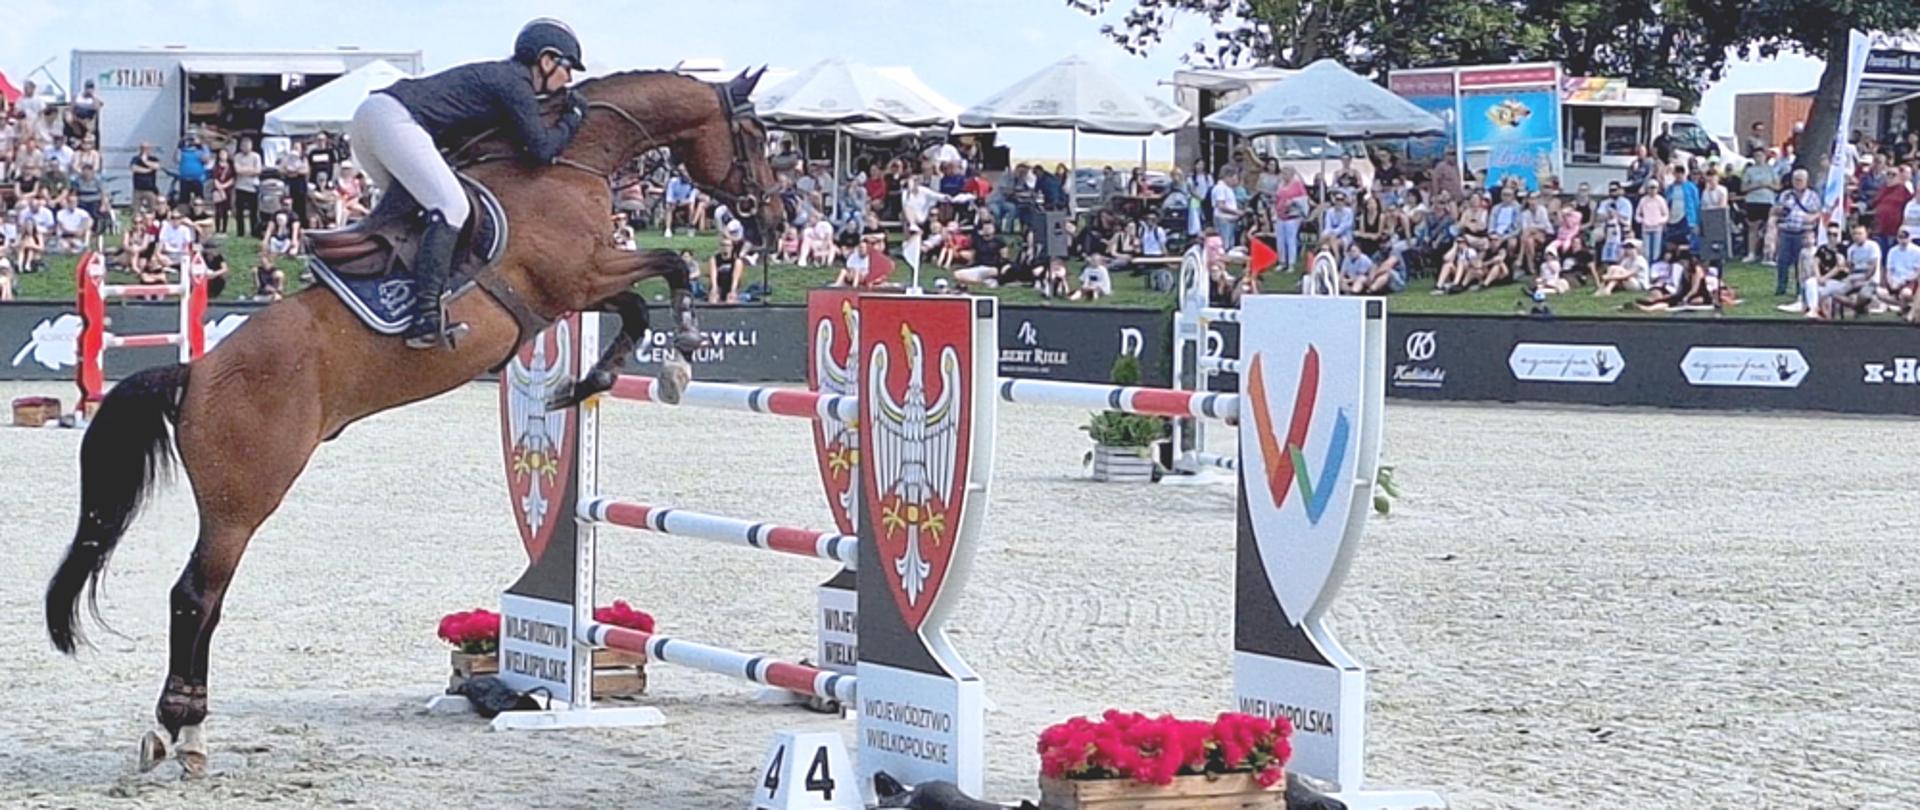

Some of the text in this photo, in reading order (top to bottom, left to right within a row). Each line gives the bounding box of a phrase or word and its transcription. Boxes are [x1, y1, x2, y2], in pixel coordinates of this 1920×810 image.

[117, 69, 164, 87] STAJNIA
[866, 728, 948, 764] WIELKOPOLSKIE
[764, 744, 785, 799] 4
[805, 746, 835, 800] 4
